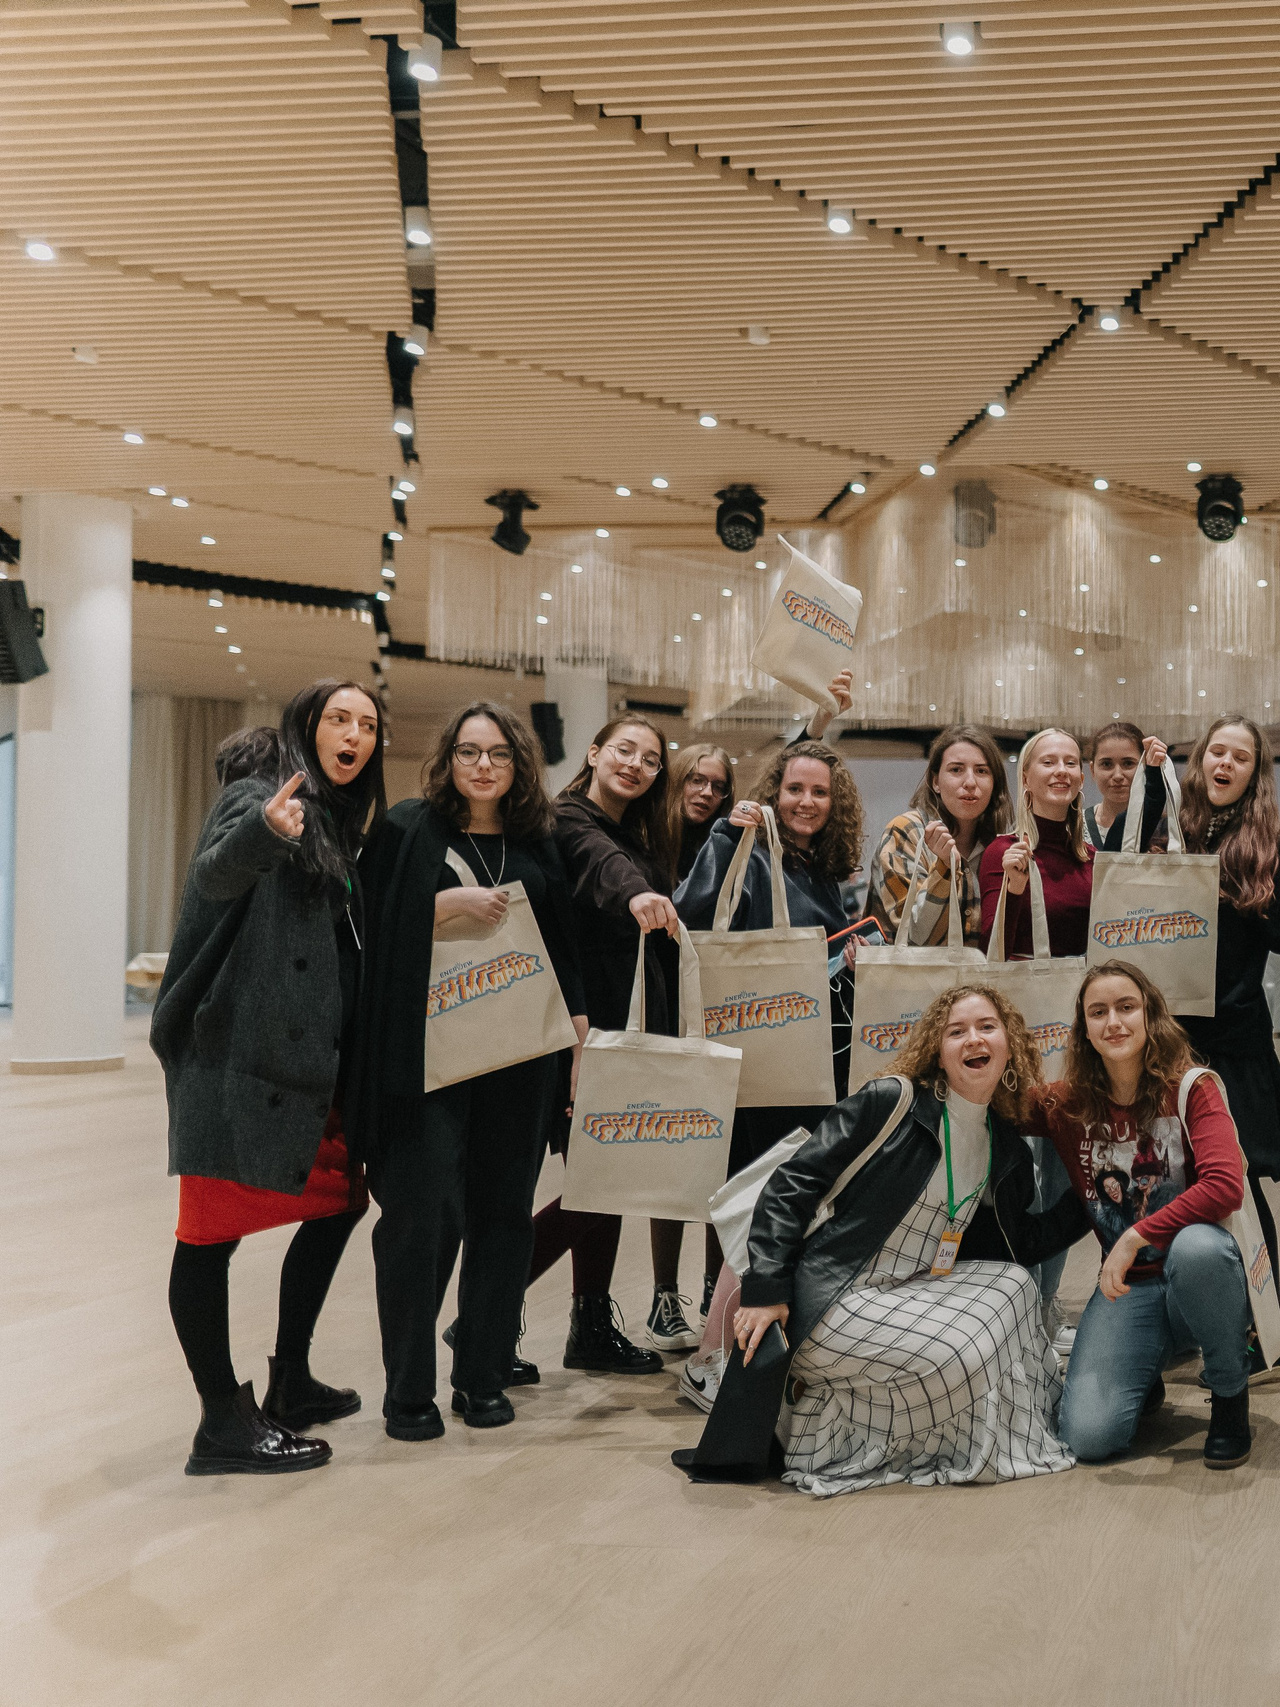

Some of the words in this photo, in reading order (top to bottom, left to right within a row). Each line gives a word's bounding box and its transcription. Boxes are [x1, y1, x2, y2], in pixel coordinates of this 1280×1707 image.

[461, 958, 542, 1001] МАДРИХ
[741, 999, 817, 1028] МАДРИХ
[638, 1119, 721, 1141] МАДРИХ
[1080, 1141, 1095, 1199] SINE
